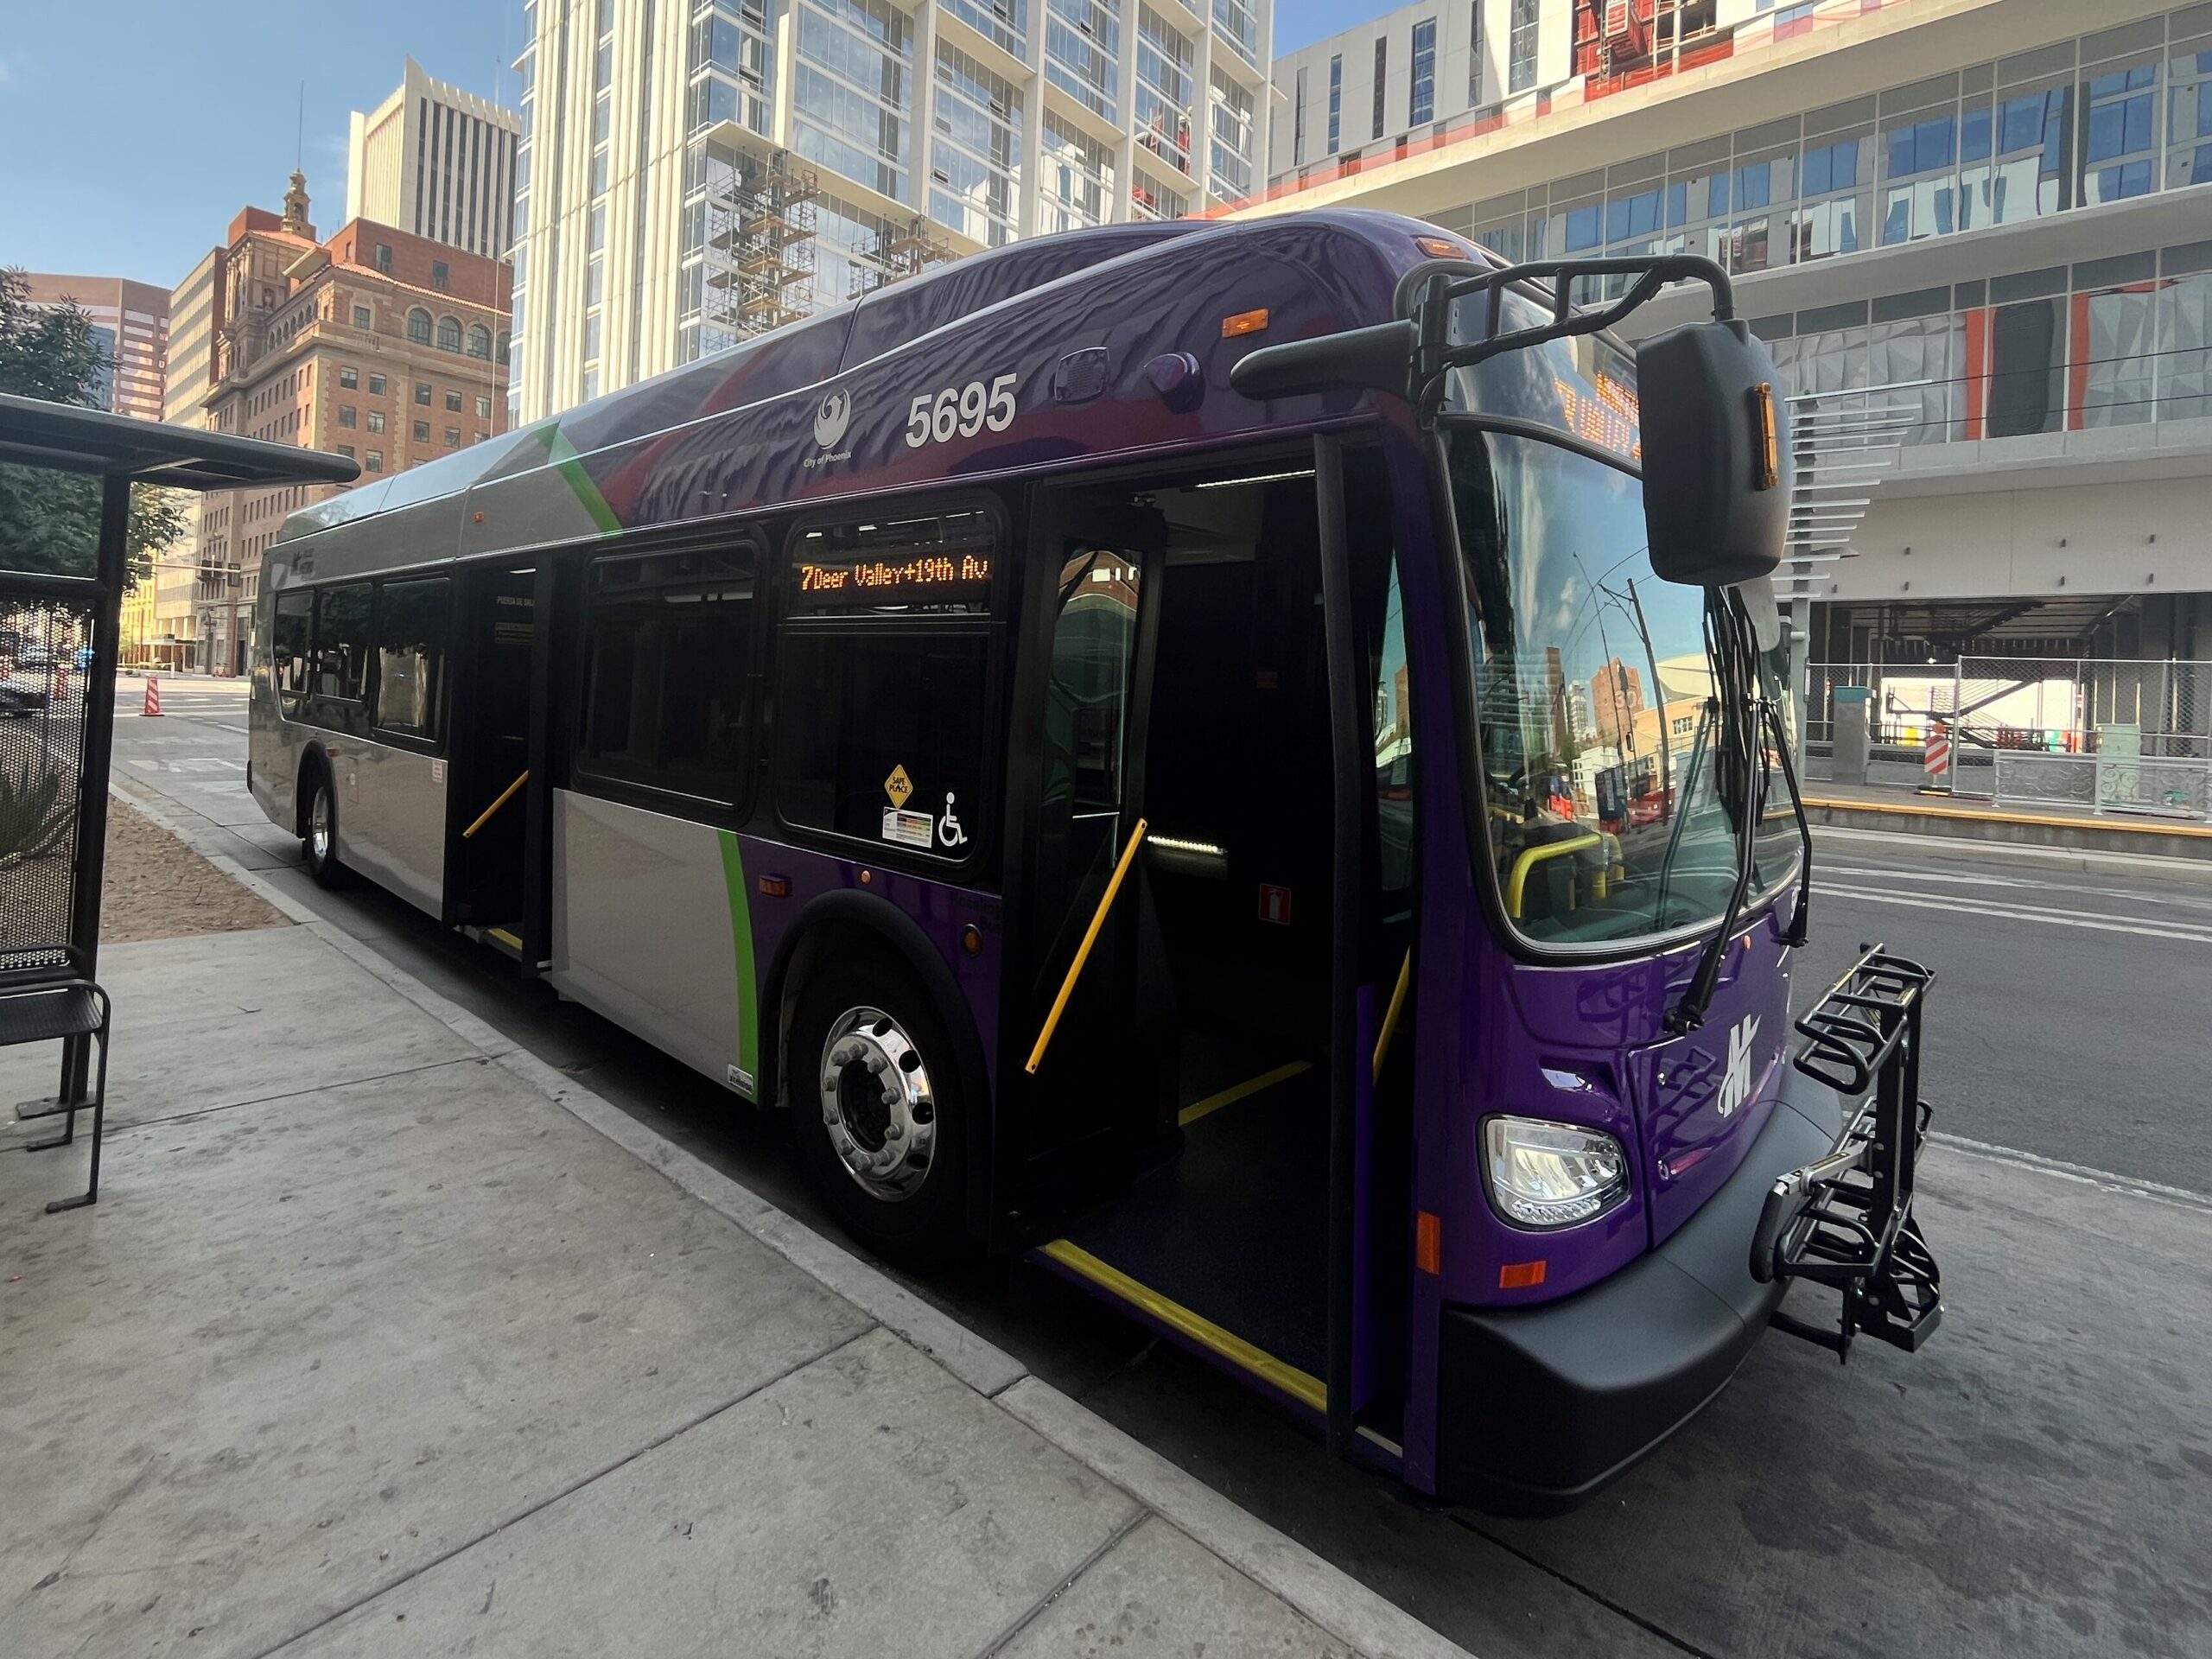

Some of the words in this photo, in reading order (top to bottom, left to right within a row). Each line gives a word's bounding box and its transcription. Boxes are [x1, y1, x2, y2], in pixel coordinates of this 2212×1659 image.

[905, 372, 1017, 448] 5695
[803, 457, 817, 468] City
[817, 454, 825, 465] of
[824, 449, 852, 463] Phoenix
[962, 554, 988, 581] Av
[888, 783, 908, 794] PLACE
[892, 776, 906, 785] SAFE
